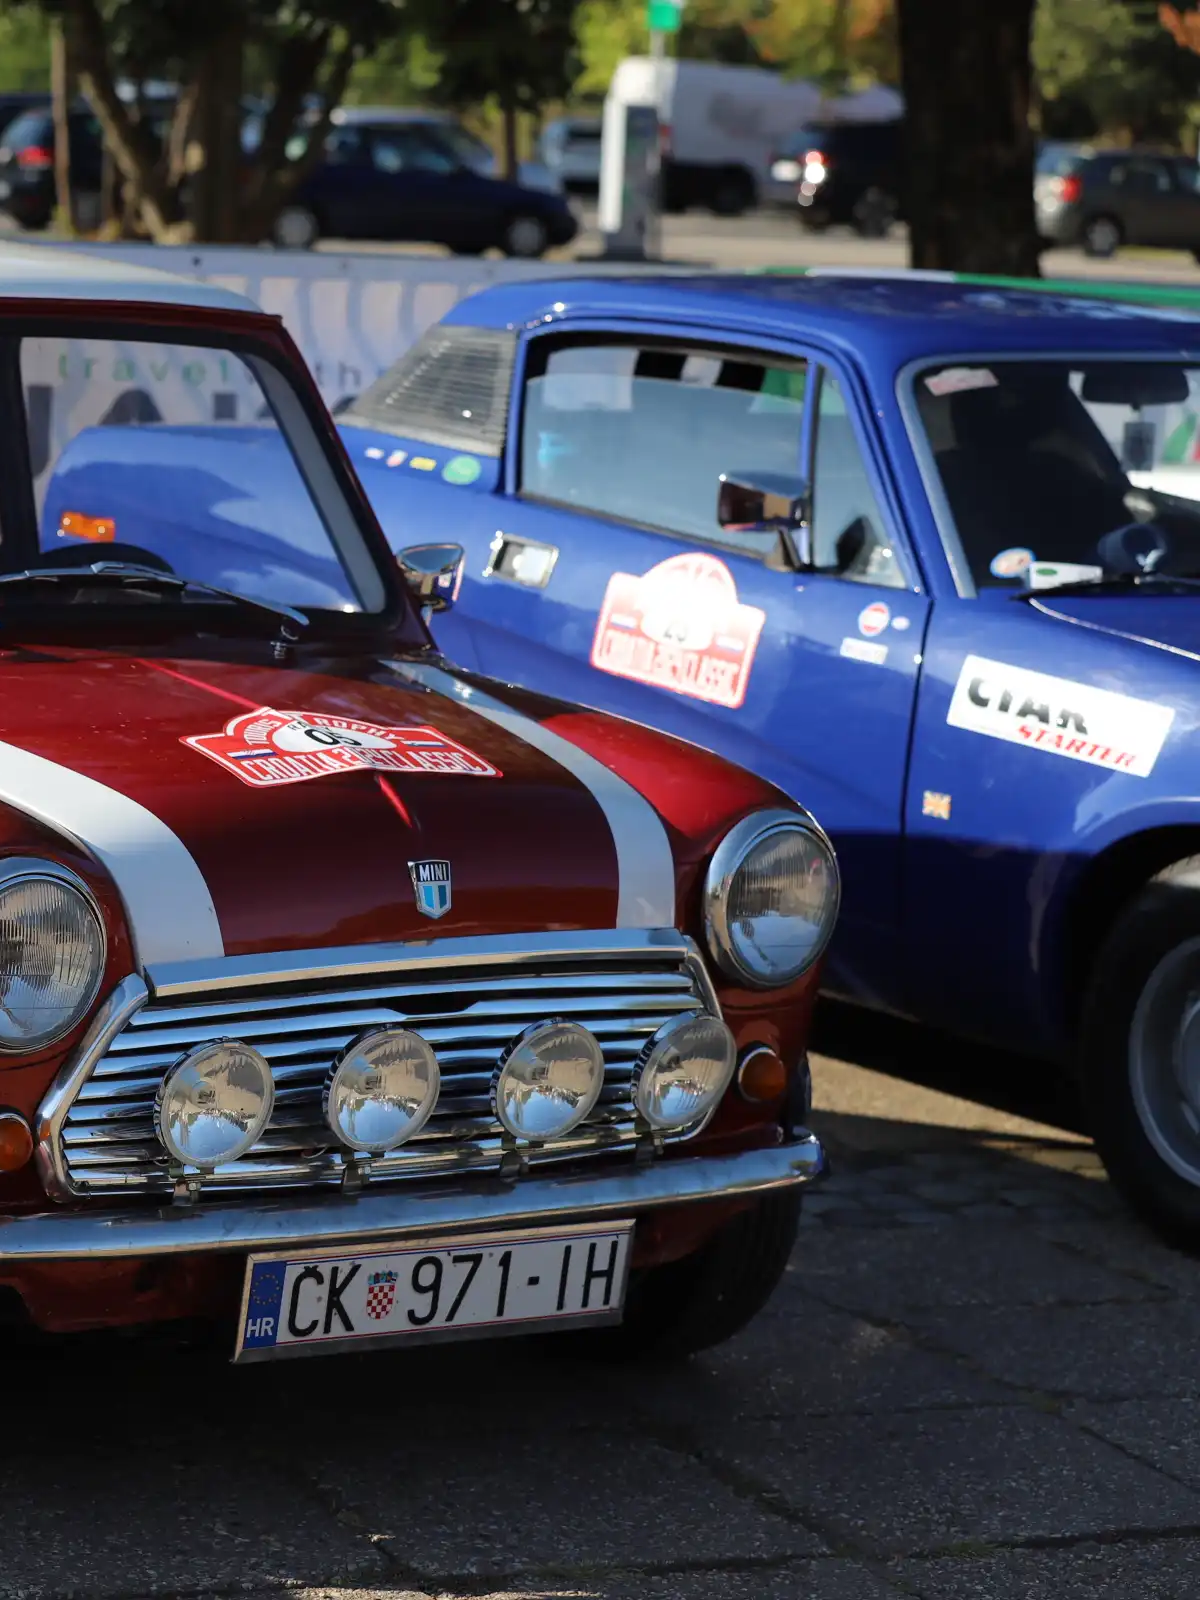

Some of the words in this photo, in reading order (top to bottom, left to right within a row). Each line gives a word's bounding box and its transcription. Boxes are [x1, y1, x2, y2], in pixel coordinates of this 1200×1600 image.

[1015, 723, 1138, 770] STARTER
[240, 751, 335, 781] CROATIA
[383, 749, 484, 773] CLASSIC
[418, 863, 447, 882] MINI
[287, 1262, 362, 1338] ČK
[406, 1239, 620, 1326] 971-IH
[245, 1316, 275, 1339] HR
